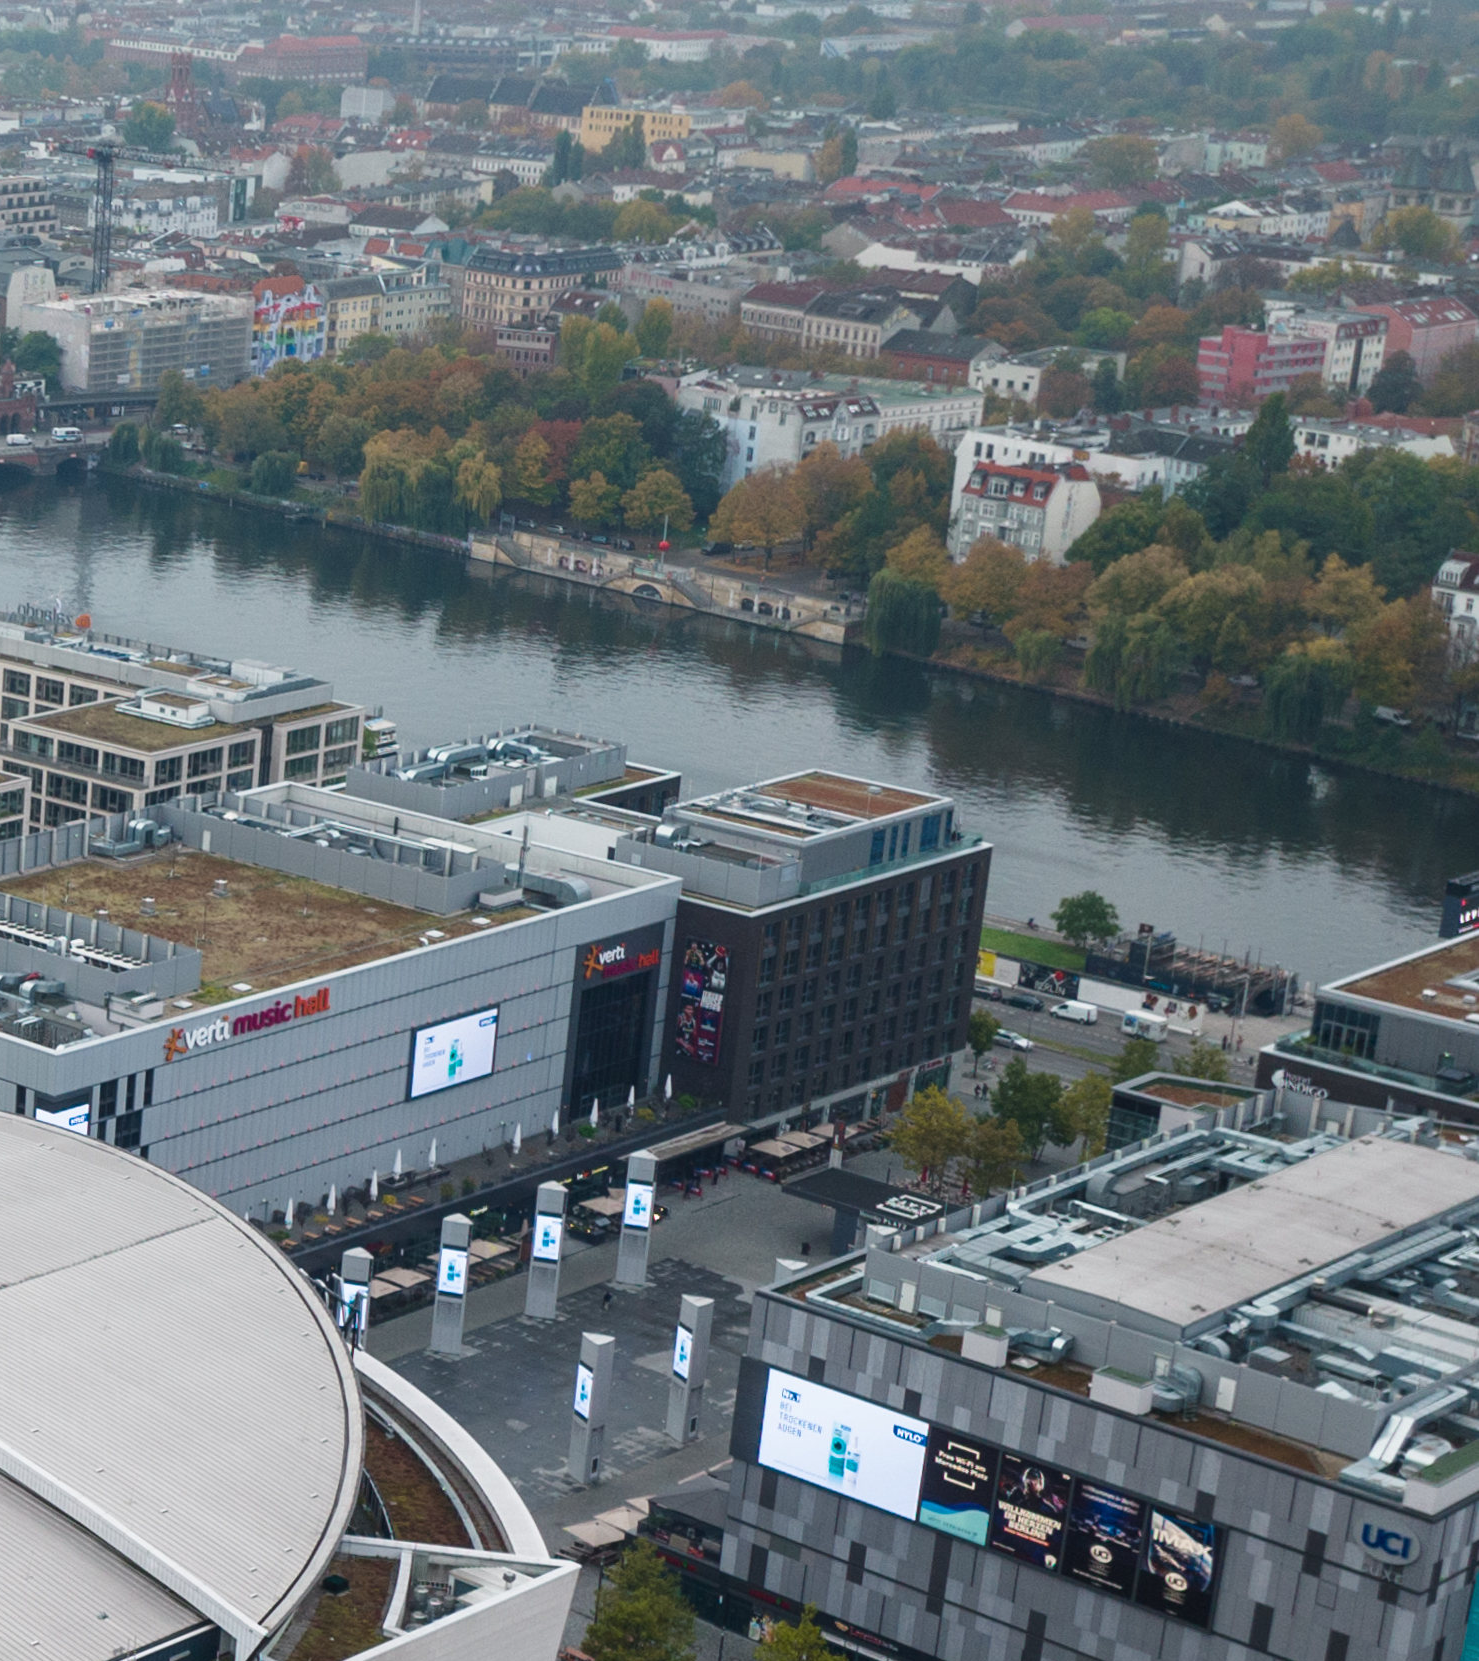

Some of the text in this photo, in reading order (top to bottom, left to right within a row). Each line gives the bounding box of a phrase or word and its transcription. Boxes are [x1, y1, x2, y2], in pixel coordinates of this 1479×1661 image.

[598, 943, 626, 964] verti
[638, 949, 659, 968] hall
[185, 986, 331, 1050] verti music hall
[780, 1401, 792, 1413] BEI
[778, 1422, 802, 1438] AUGEN
[780, 1412, 822, 1434] TROCKENEN
[939, 1450, 955, 1461] Free
[935, 1456, 988, 1481] Mercedes Platz
[998, 1500, 1062, 1531] WILLKOMMEN
[1017, 1512, 1053, 1535] HERZEN
[1008, 1520, 1047, 1540] BERLINS
[1361, 1522, 1412, 1560] UCI
[1153, 1527, 1212, 1560] IMAX
